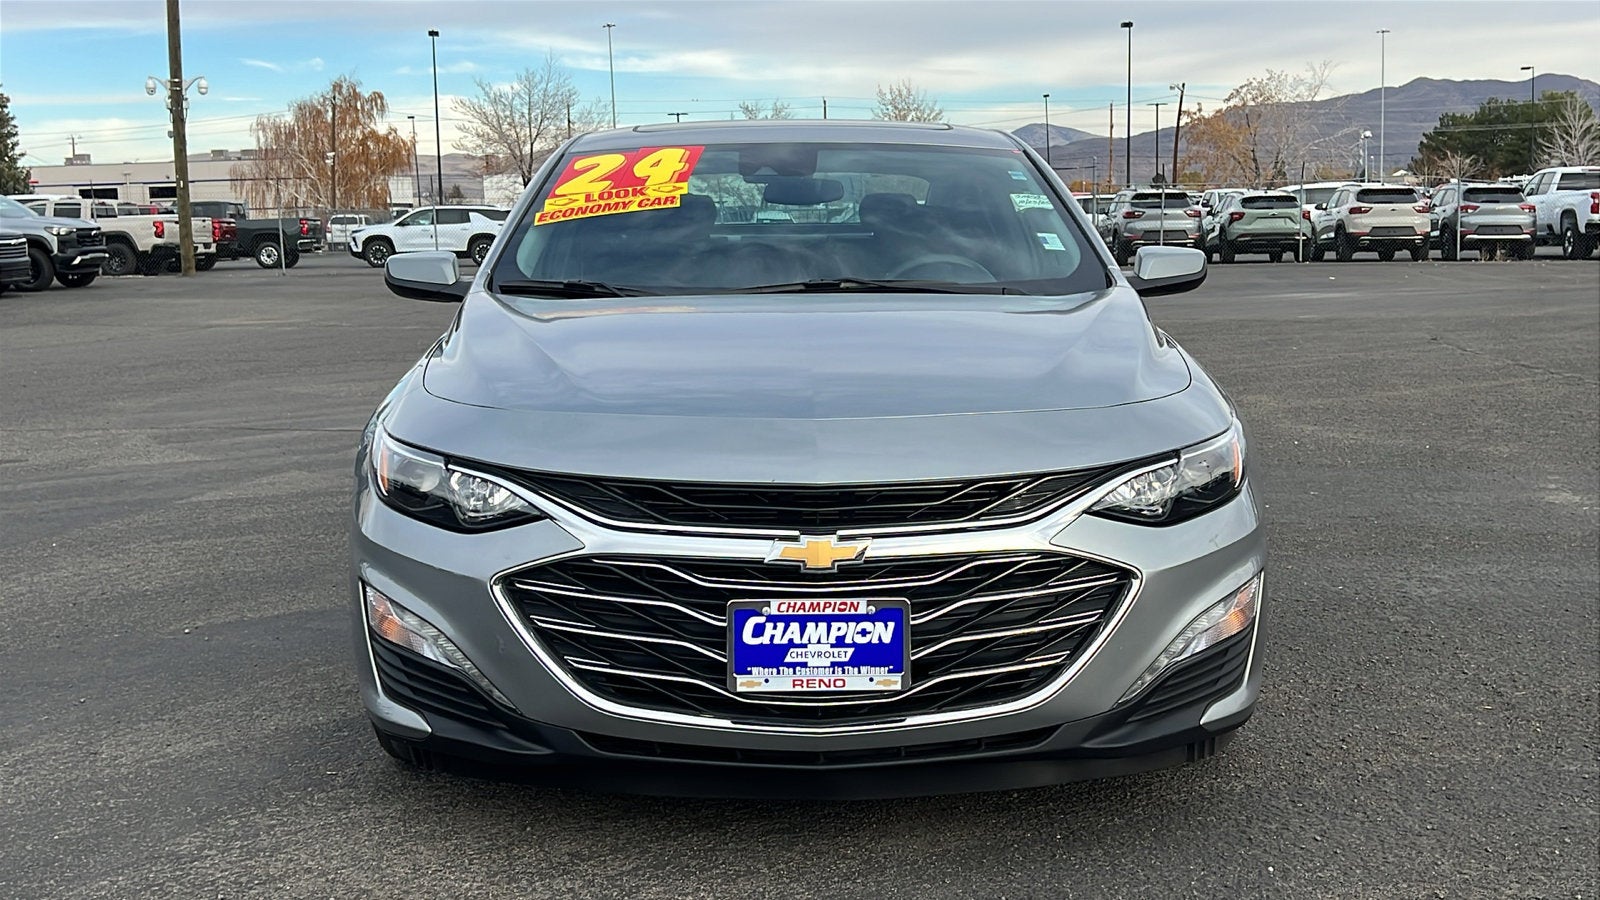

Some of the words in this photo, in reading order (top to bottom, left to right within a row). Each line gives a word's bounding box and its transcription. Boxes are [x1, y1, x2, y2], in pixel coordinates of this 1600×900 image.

[555, 148, 689, 196] 24
[585, 186, 648, 203] LOOK
[537, 200, 633, 223] ECONOMY
[637, 196, 677, 208] CAR
[777, 601, 860, 613] CHAMPION
[742, 615, 895, 645] CHAMPION
[789, 650, 848, 659] CHEVROLET
[779, 666, 793, 676] The
[796, 665, 833, 675] Customer
[844, 665, 858, 675] The
[792, 678, 846, 688] RENO
